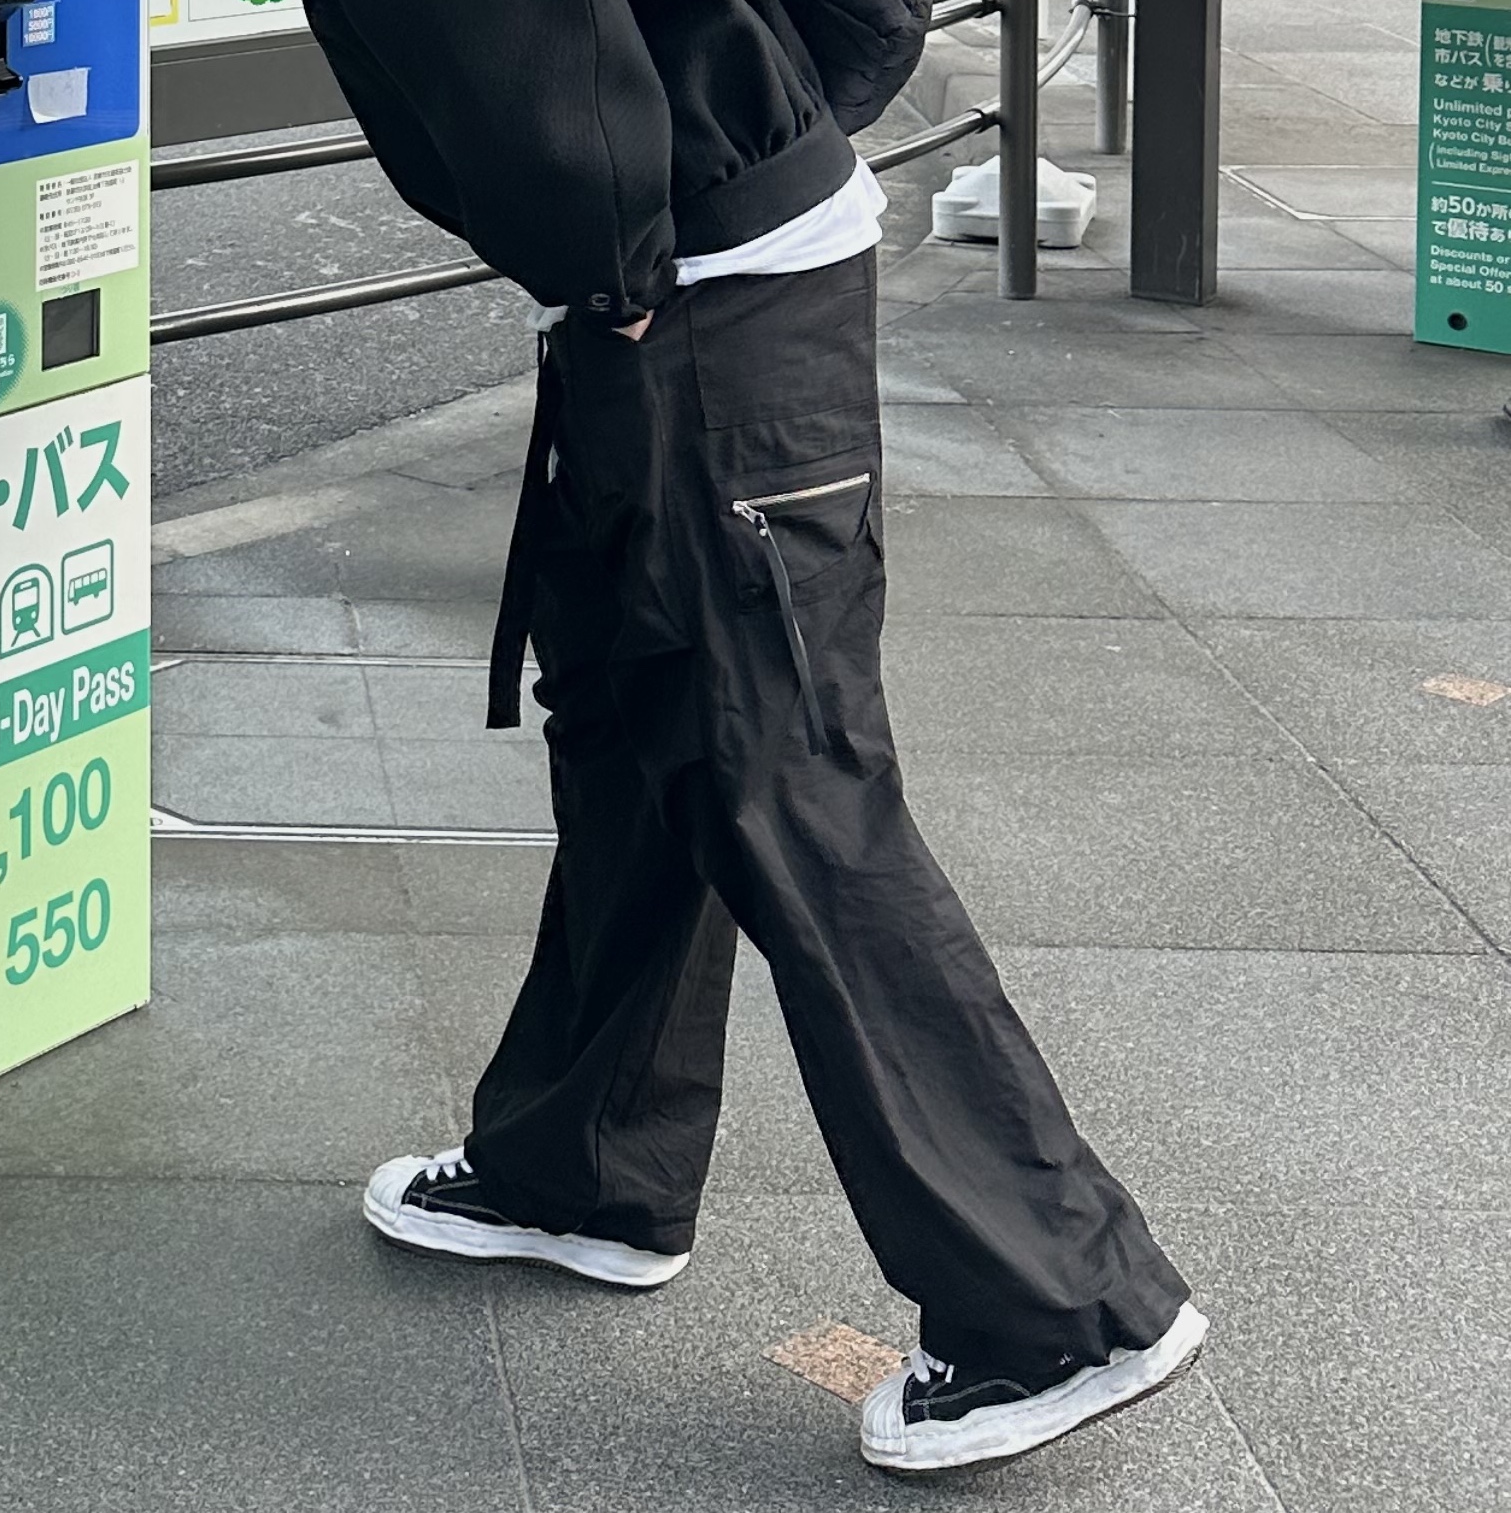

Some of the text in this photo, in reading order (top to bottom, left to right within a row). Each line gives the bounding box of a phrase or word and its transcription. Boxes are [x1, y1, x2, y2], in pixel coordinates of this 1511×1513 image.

[1434, 28, 1484, 48] 地下鉄
[1434, 48, 1483, 67] 市バス
[1433, 98, 1503, 117] Unlimited
[1430, 245, 1494, 263] Discounts
[72, 659, 136, 722] Pass
[4, 877, 111, 987] 550
